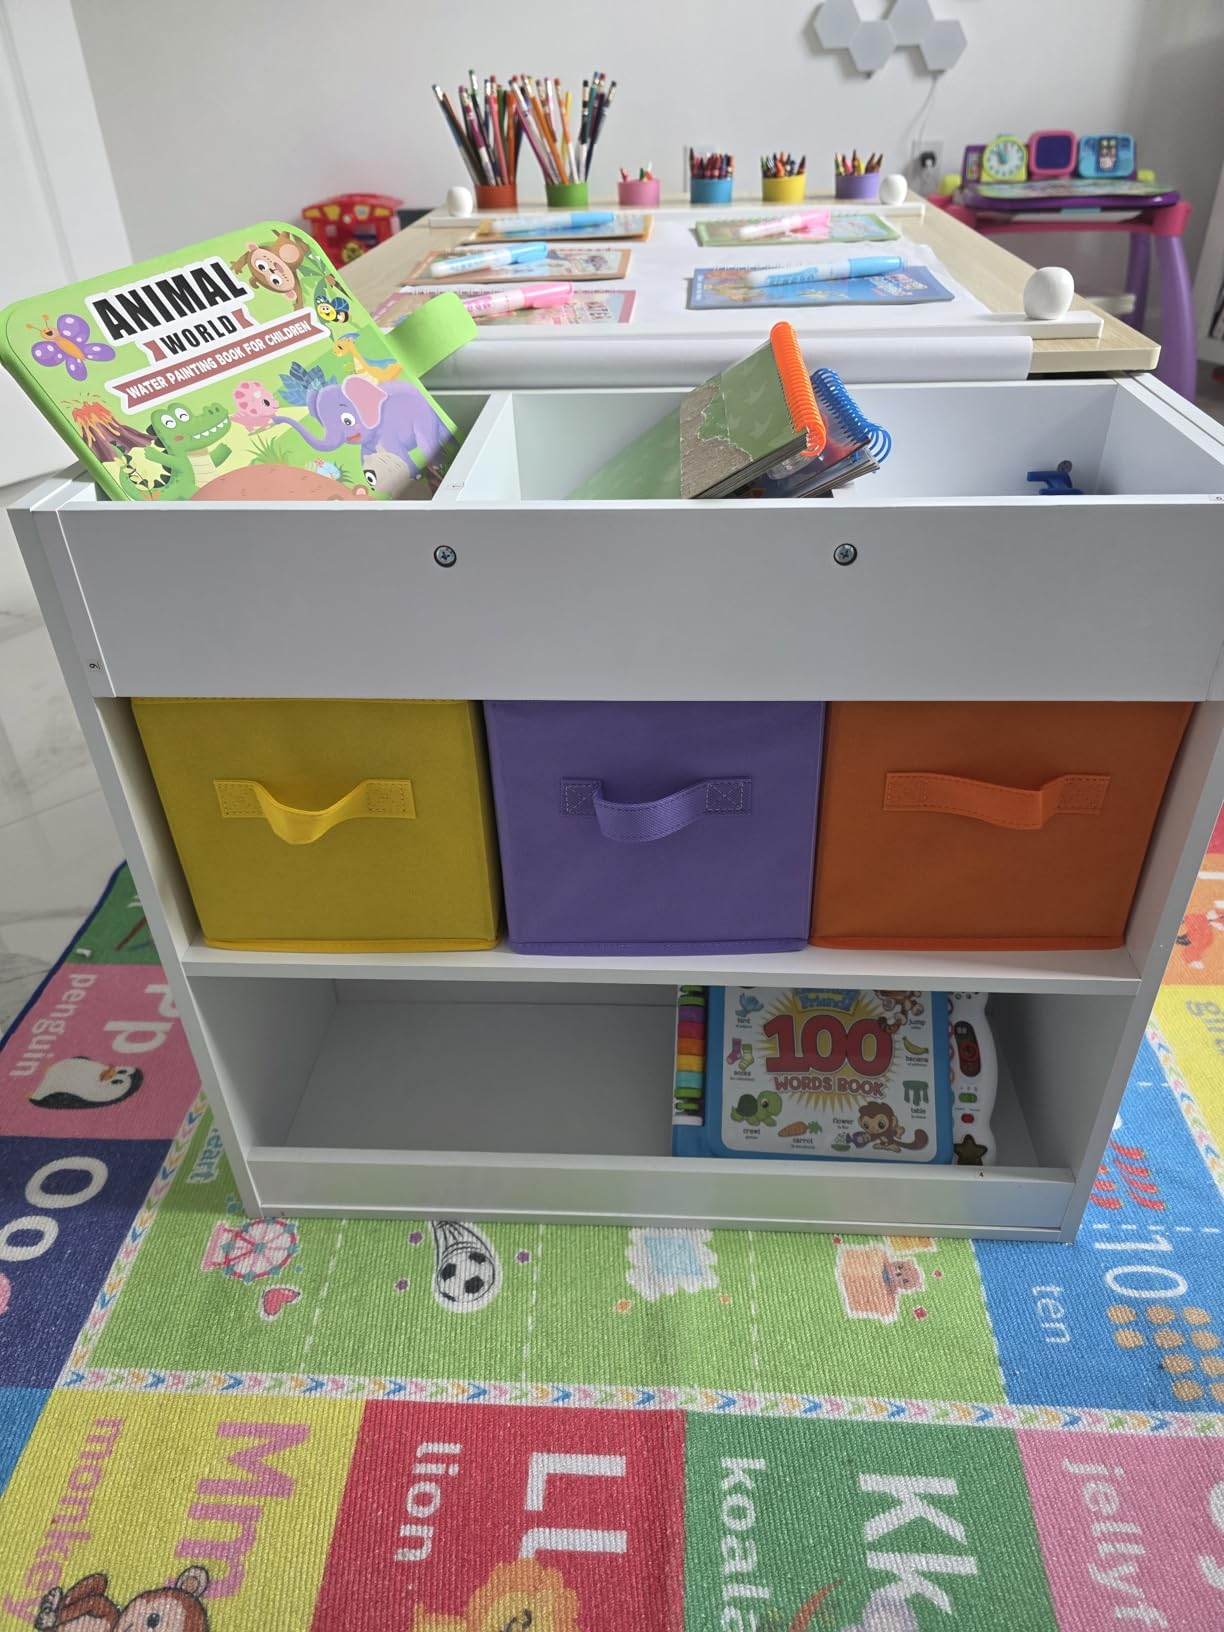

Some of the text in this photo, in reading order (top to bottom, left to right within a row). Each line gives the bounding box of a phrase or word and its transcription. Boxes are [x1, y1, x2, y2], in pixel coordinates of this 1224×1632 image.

[92, 262, 248, 340] ANIMAL
[159, 314, 238, 355] WORLD
[126, 320, 312, 399] WATER PAINTING BOOK FOR CHILDREN
[9, 973, 99, 1077] penguin
[763, 1014, 893, 1077] 100
[774, 1076, 885, 1097] WORDS BOOK
[0, 1156, 108, 1261] Oo
[1032, 1285, 1071, 1343] ten
[1094, 1234, 1189, 1298] 10
[1, 1418, 125, 1625] monkey
[165, 1421, 310, 1601] Mm
[394, 1441, 463, 1562] lion
[519, 1452, 628, 1559] Ll
[721, 1457, 771, 1632] koala
[858, 1472, 978, 1615] Kk
